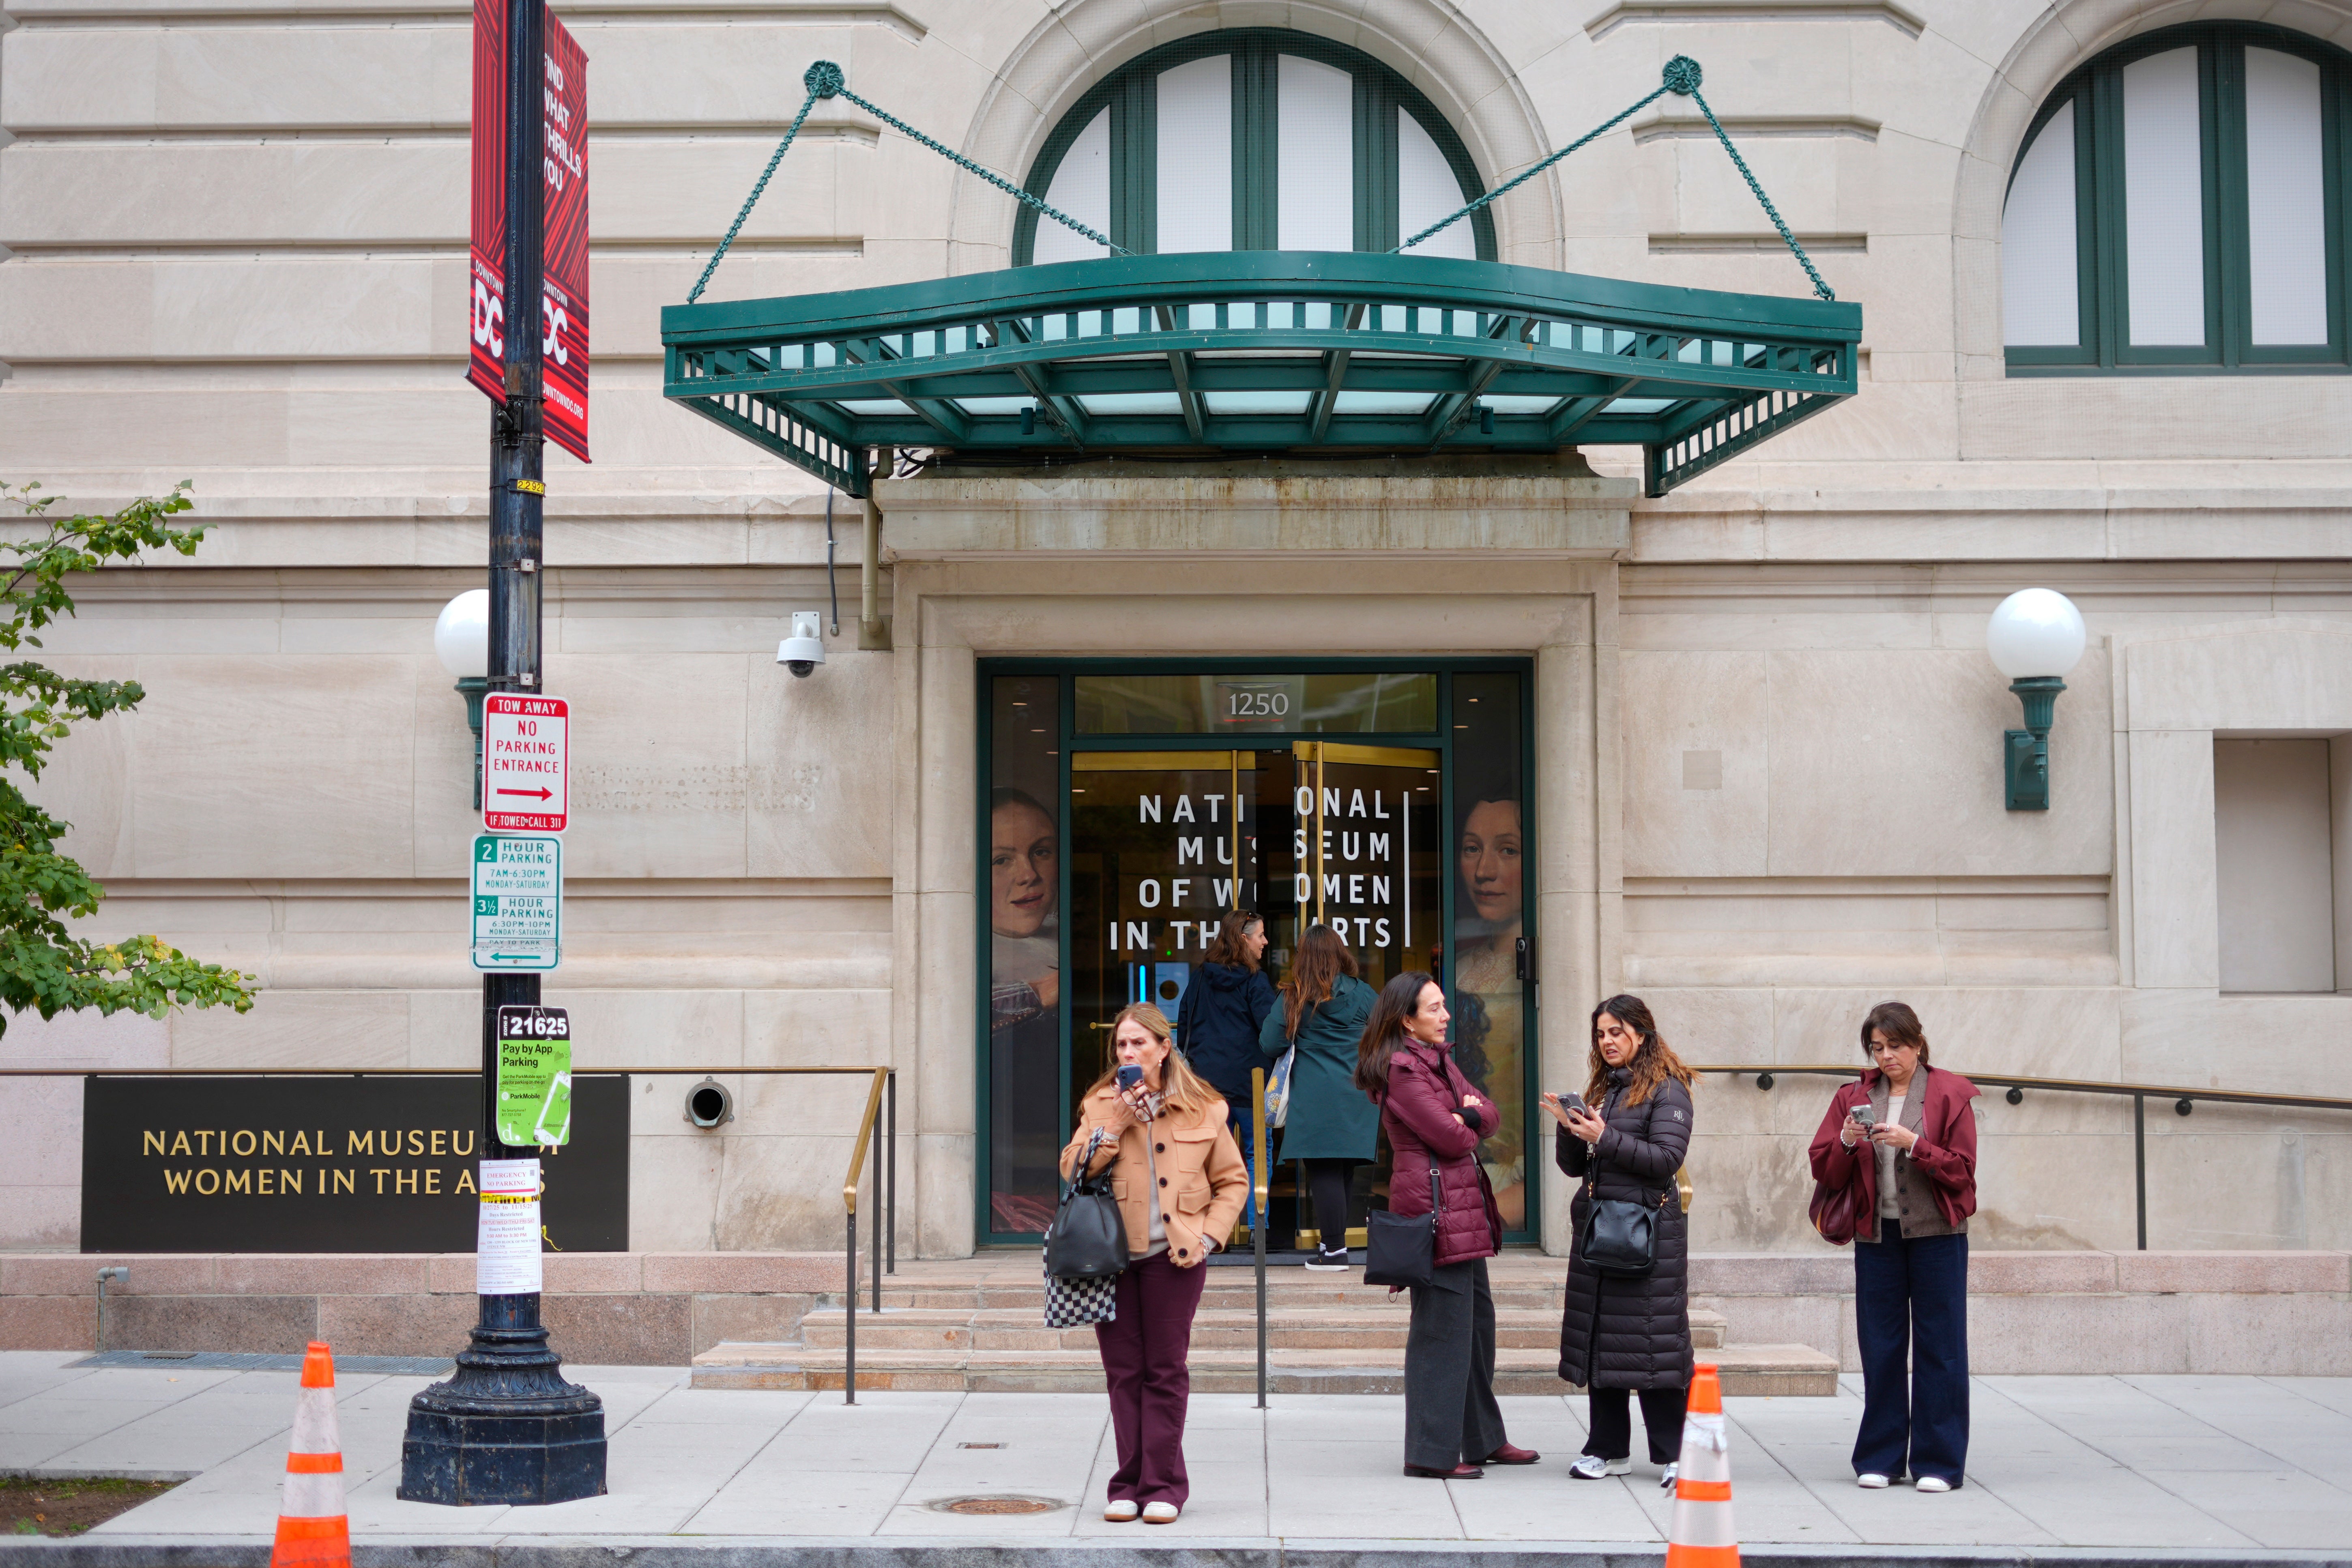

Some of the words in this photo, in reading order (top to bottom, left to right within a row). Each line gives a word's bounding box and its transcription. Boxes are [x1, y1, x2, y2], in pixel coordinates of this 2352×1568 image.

[476, 259, 503, 295] DOWNTOWN
[543, 278, 567, 307] OWNTOWN
[475, 278, 503, 357] DC
[543, 381, 583, 420] OWNTOWNDC.ORG
[518, 481, 543, 492] 22920
[498, 700, 520, 712] TOW
[525, 702, 557, 714] AWAY
[1229, 693, 1289, 715] 1250
[518, 720, 537, 736] NO
[496, 740, 555, 754] PARKING
[494, 759, 558, 773] ENTRANCE
[490, 815, 497, 825] IF
[500, 816, 525, 827] TOWED
[528, 817, 548, 827] CALL
[550, 818, 561, 828] 311
[482, 844, 492, 860] 2
[503, 842, 544, 852] HOUR
[502, 854, 552, 863] PARKING
[490, 869, 545, 878] 7AM-6:30PM
[486, 880, 550, 889] MONDAY-SATURDAY
[1139, 879, 1190, 908] OF
[509, 898, 543, 907] HOUR
[502, 909, 553, 918] PARKING
[1110, 921, 1148, 950] IN
[1170, 921, 1220, 949] TH
[510, 1017, 567, 1034] 21625
[503, 1044, 520, 1055] Pay
[522, 1044, 533, 1055] by
[535, 1044, 552, 1055] App
[503, 1057, 538, 1068] Parking
[143, 1130, 333, 1156] NATIONAL
[347, 1130, 475, 1156] MUSEU
[164, 1169, 302, 1195] WOMEN
[318, 1169, 356, 1194] IN
[369, 1169, 441, 1194] THE
